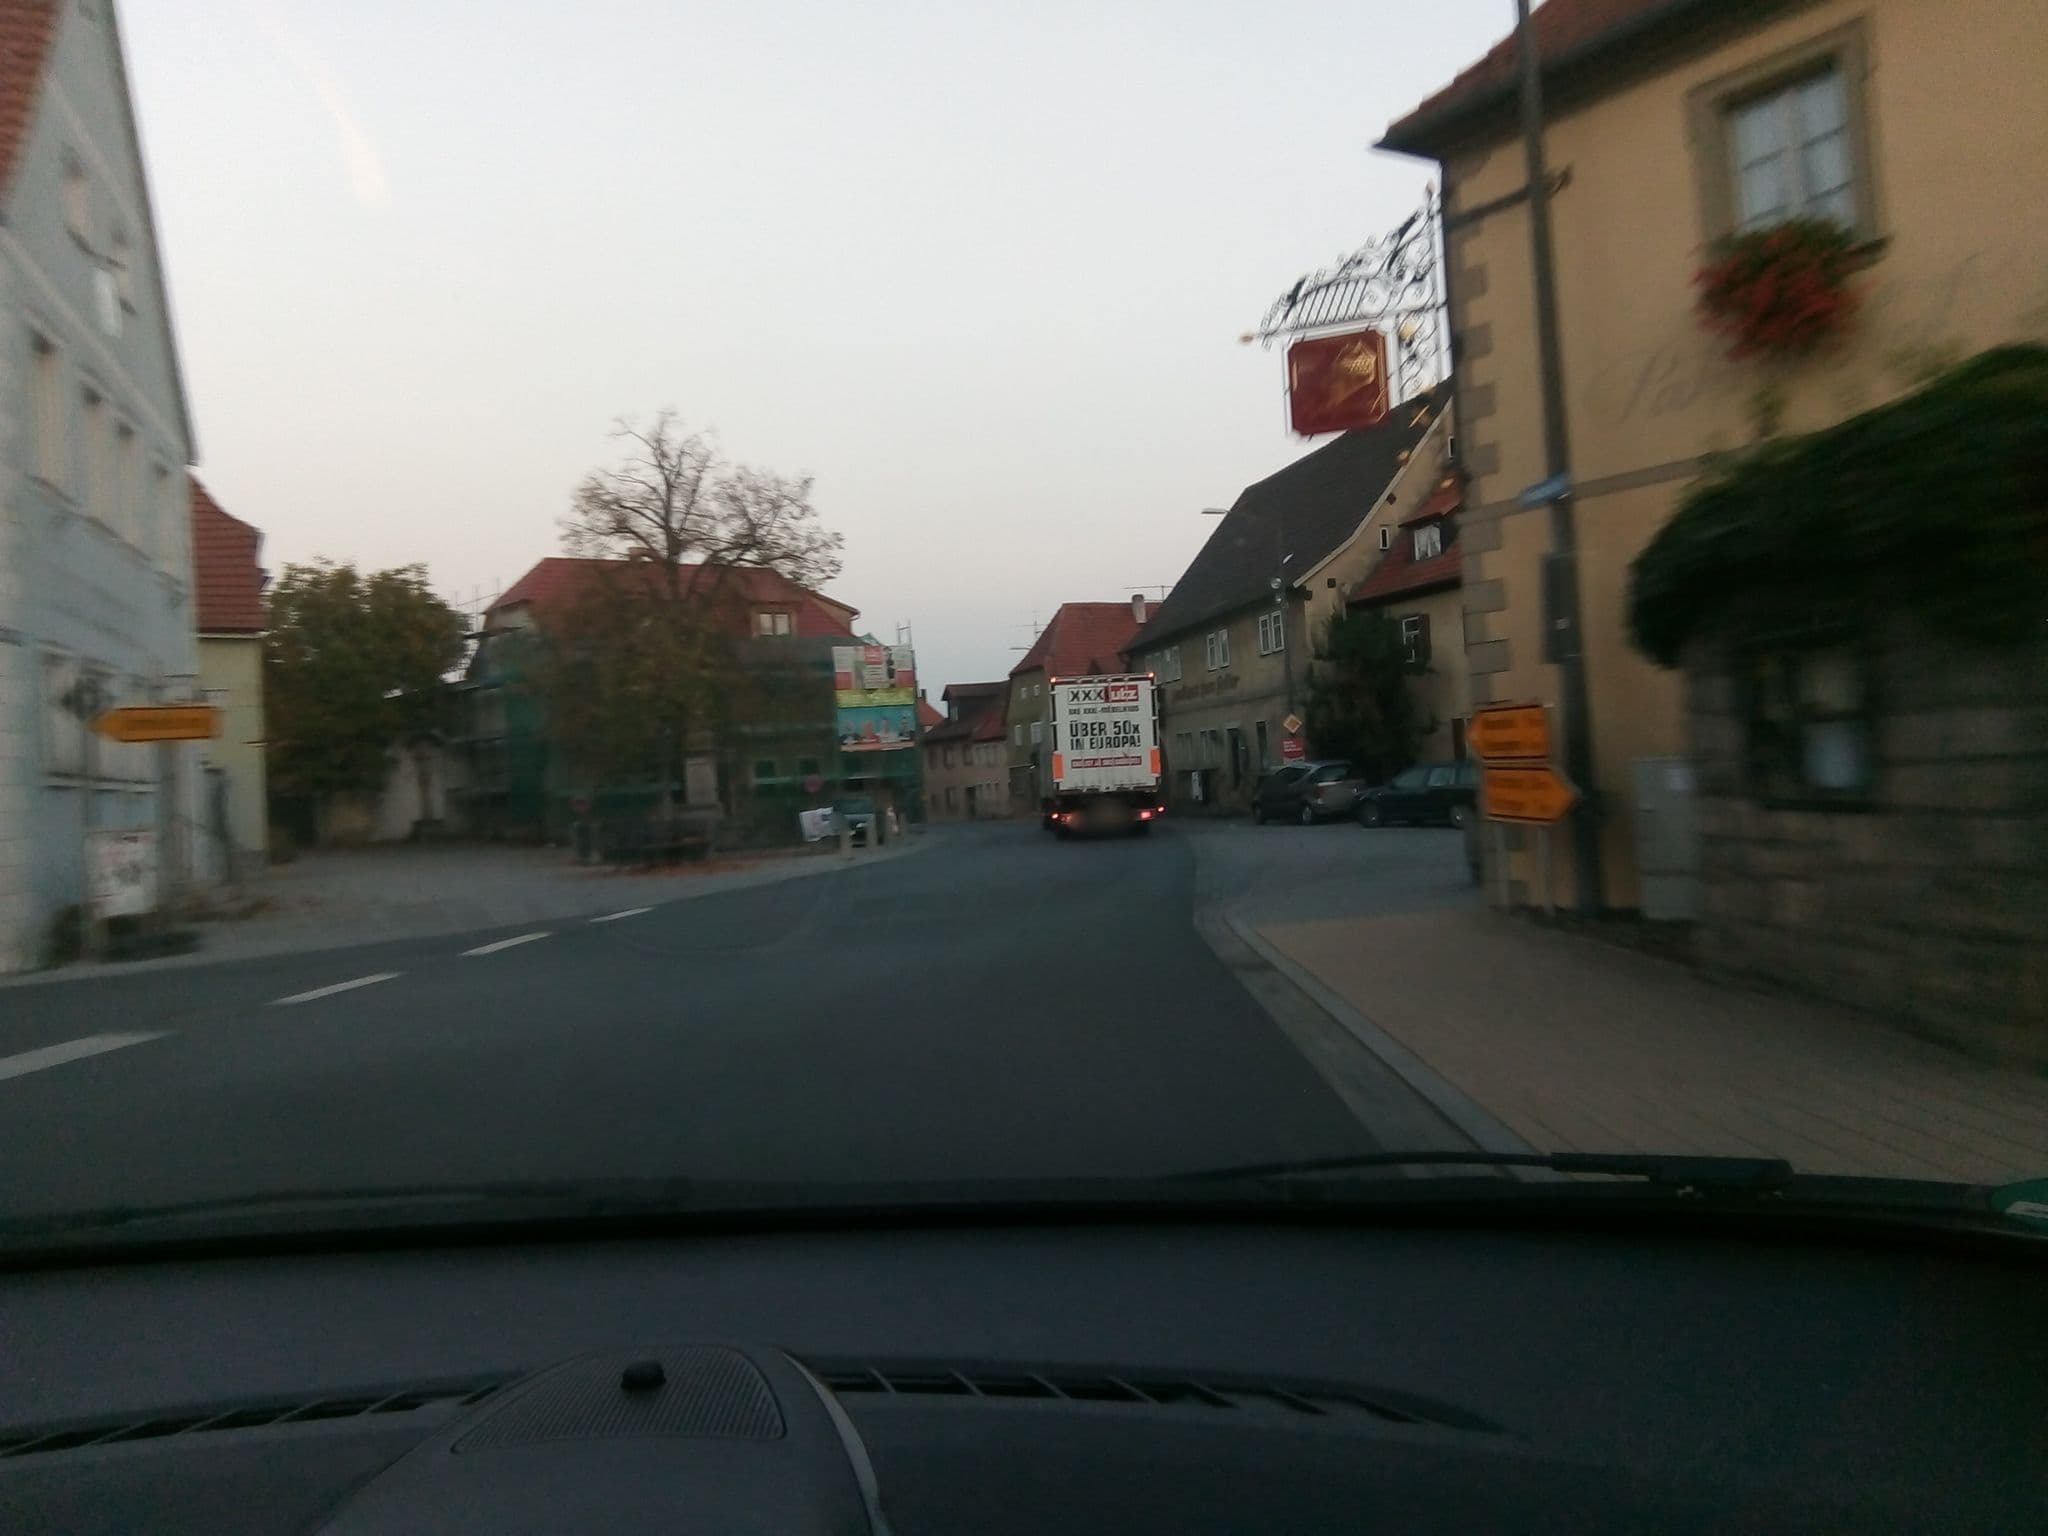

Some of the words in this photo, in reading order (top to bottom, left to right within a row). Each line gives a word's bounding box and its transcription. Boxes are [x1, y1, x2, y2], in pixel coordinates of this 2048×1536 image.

[1070, 720, 1107, 737] ÜBER
[1113, 720, 1141, 734] 50x
[1070, 738, 1085, 750] IN
[1089, 735, 1141, 749] EUROPA!
